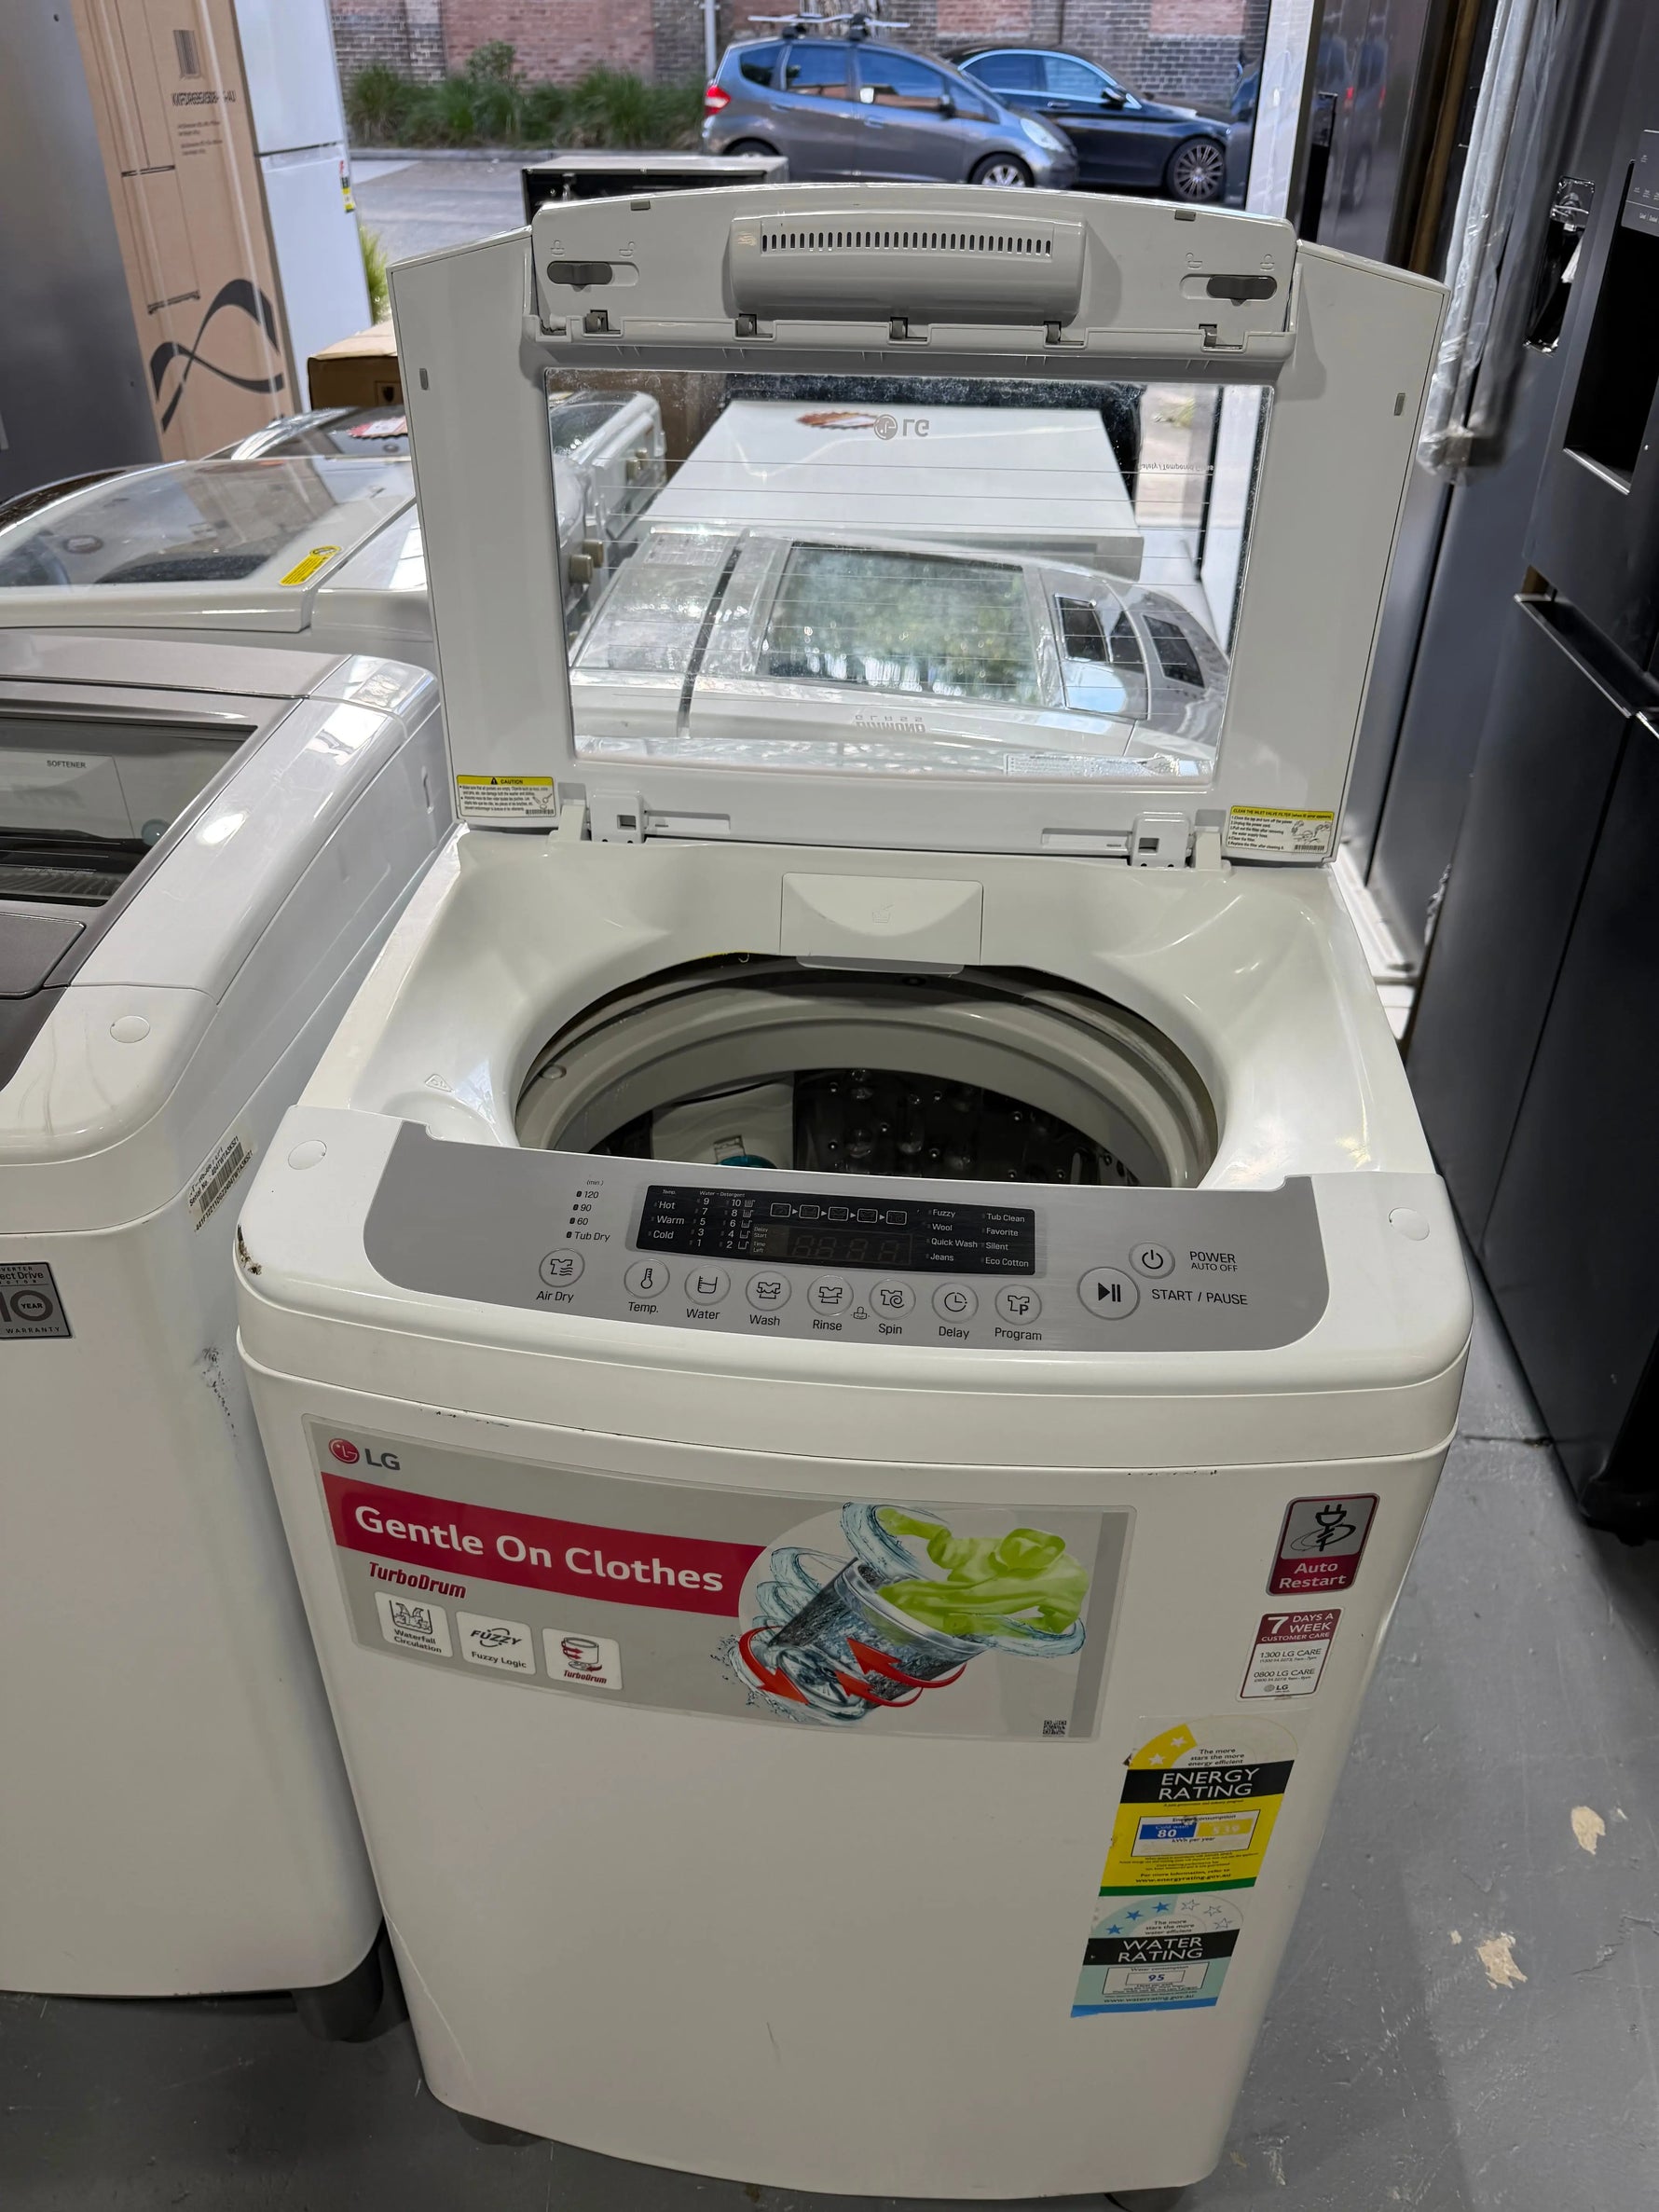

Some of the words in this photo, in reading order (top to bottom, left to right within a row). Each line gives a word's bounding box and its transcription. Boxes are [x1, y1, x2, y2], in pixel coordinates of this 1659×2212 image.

[47, 760, 87, 768] SOFTENER
[583, 1190, 599, 1199] 120
[580, 1203, 592, 1212] 90
[658, 1201, 676, 1210] Hot
[732, 1199, 741, 1207] 10
[932, 1209, 955, 1218] Fuzzy
[986, 1214, 1001, 1222] Tub
[1003, 1215, 1025, 1223] Clean
[577, 1216, 589, 1226] 60
[656, 1216, 685, 1225] Warm
[730, 1219, 736, 1228] 6
[932, 1223, 953, 1231] Wool
[986, 1228, 1019, 1237] Favorite
[574, 1231, 592, 1241] Tub
[593, 1232, 610, 1243] Dry
[652, 1230, 674, 1239] Cold
[728, 1230, 734, 1238] 4
[726, 1241, 733, 1249] 2
[931, 1238, 953, 1246] Quick
[955, 1239, 978, 1248] Wash
[985, 1242, 1008, 1251] Silent
[930, 1252, 954, 1262] Jeans
[985, 1257, 1000, 1266] Eco
[1002, 1258, 1029, 1268] Cotton
[1189, 1250, 1236, 1264] POWER
[1191, 1262, 1217, 1271] AUTO
[1219, 1263, 1238, 1272] OFF
[536, 1290, 553, 1301] Air
[555, 1291, 574, 1303] Dry
[1151, 1288, 1193, 1302] START
[1206, 1292, 1248, 1306] PAUSE
[628, 1301, 659, 1314] Temp.
[686, 1308, 720, 1320] Water
[749, 1314, 781, 1326] Wash
[812, 1319, 843, 1331] Rinse
[878, 1324, 903, 1336] Spin
[939, 1326, 970, 1340] Delay
[994, 1327, 1043, 1341] Program
[364, 1448, 401, 1471] LG
[355, 1505, 484, 1556] Gentle
[496, 1535, 553, 1568] On
[565, 1546, 723, 1592] Clothes
[1294, 1562, 1338, 1574] Auto
[369, 1561, 466, 1600] TurboDrum
[1279, 1574, 1347, 1589] Restart
[1268, 1616, 1290, 1634] 7
[1293, 1614, 1323, 1622] DAYS
[1290, 1621, 1332, 1633] WEEK
[394, 1628, 437, 1644] Waterfall
[470, 1629, 522, 1645] FUZZY
[394, 1636, 442, 1654] Circulation
[1296, 1648, 1322, 1656] CARE
[471, 1651, 499, 1664] Fuzzy
[500, 1656, 527, 1669] Logic
[563, 1669, 607, 1684] TurboDrum
[1161, 1767, 1260, 1786] ENERGY
[1159, 1783, 1253, 1801] RATING
[1157, 1829, 1177, 1838] 80
[1135, 1874, 1231, 1883] www.energyrating.gov.au
[1123, 1937, 1202, 1950] WATER
[1118, 1948, 1203, 1962] RATING
